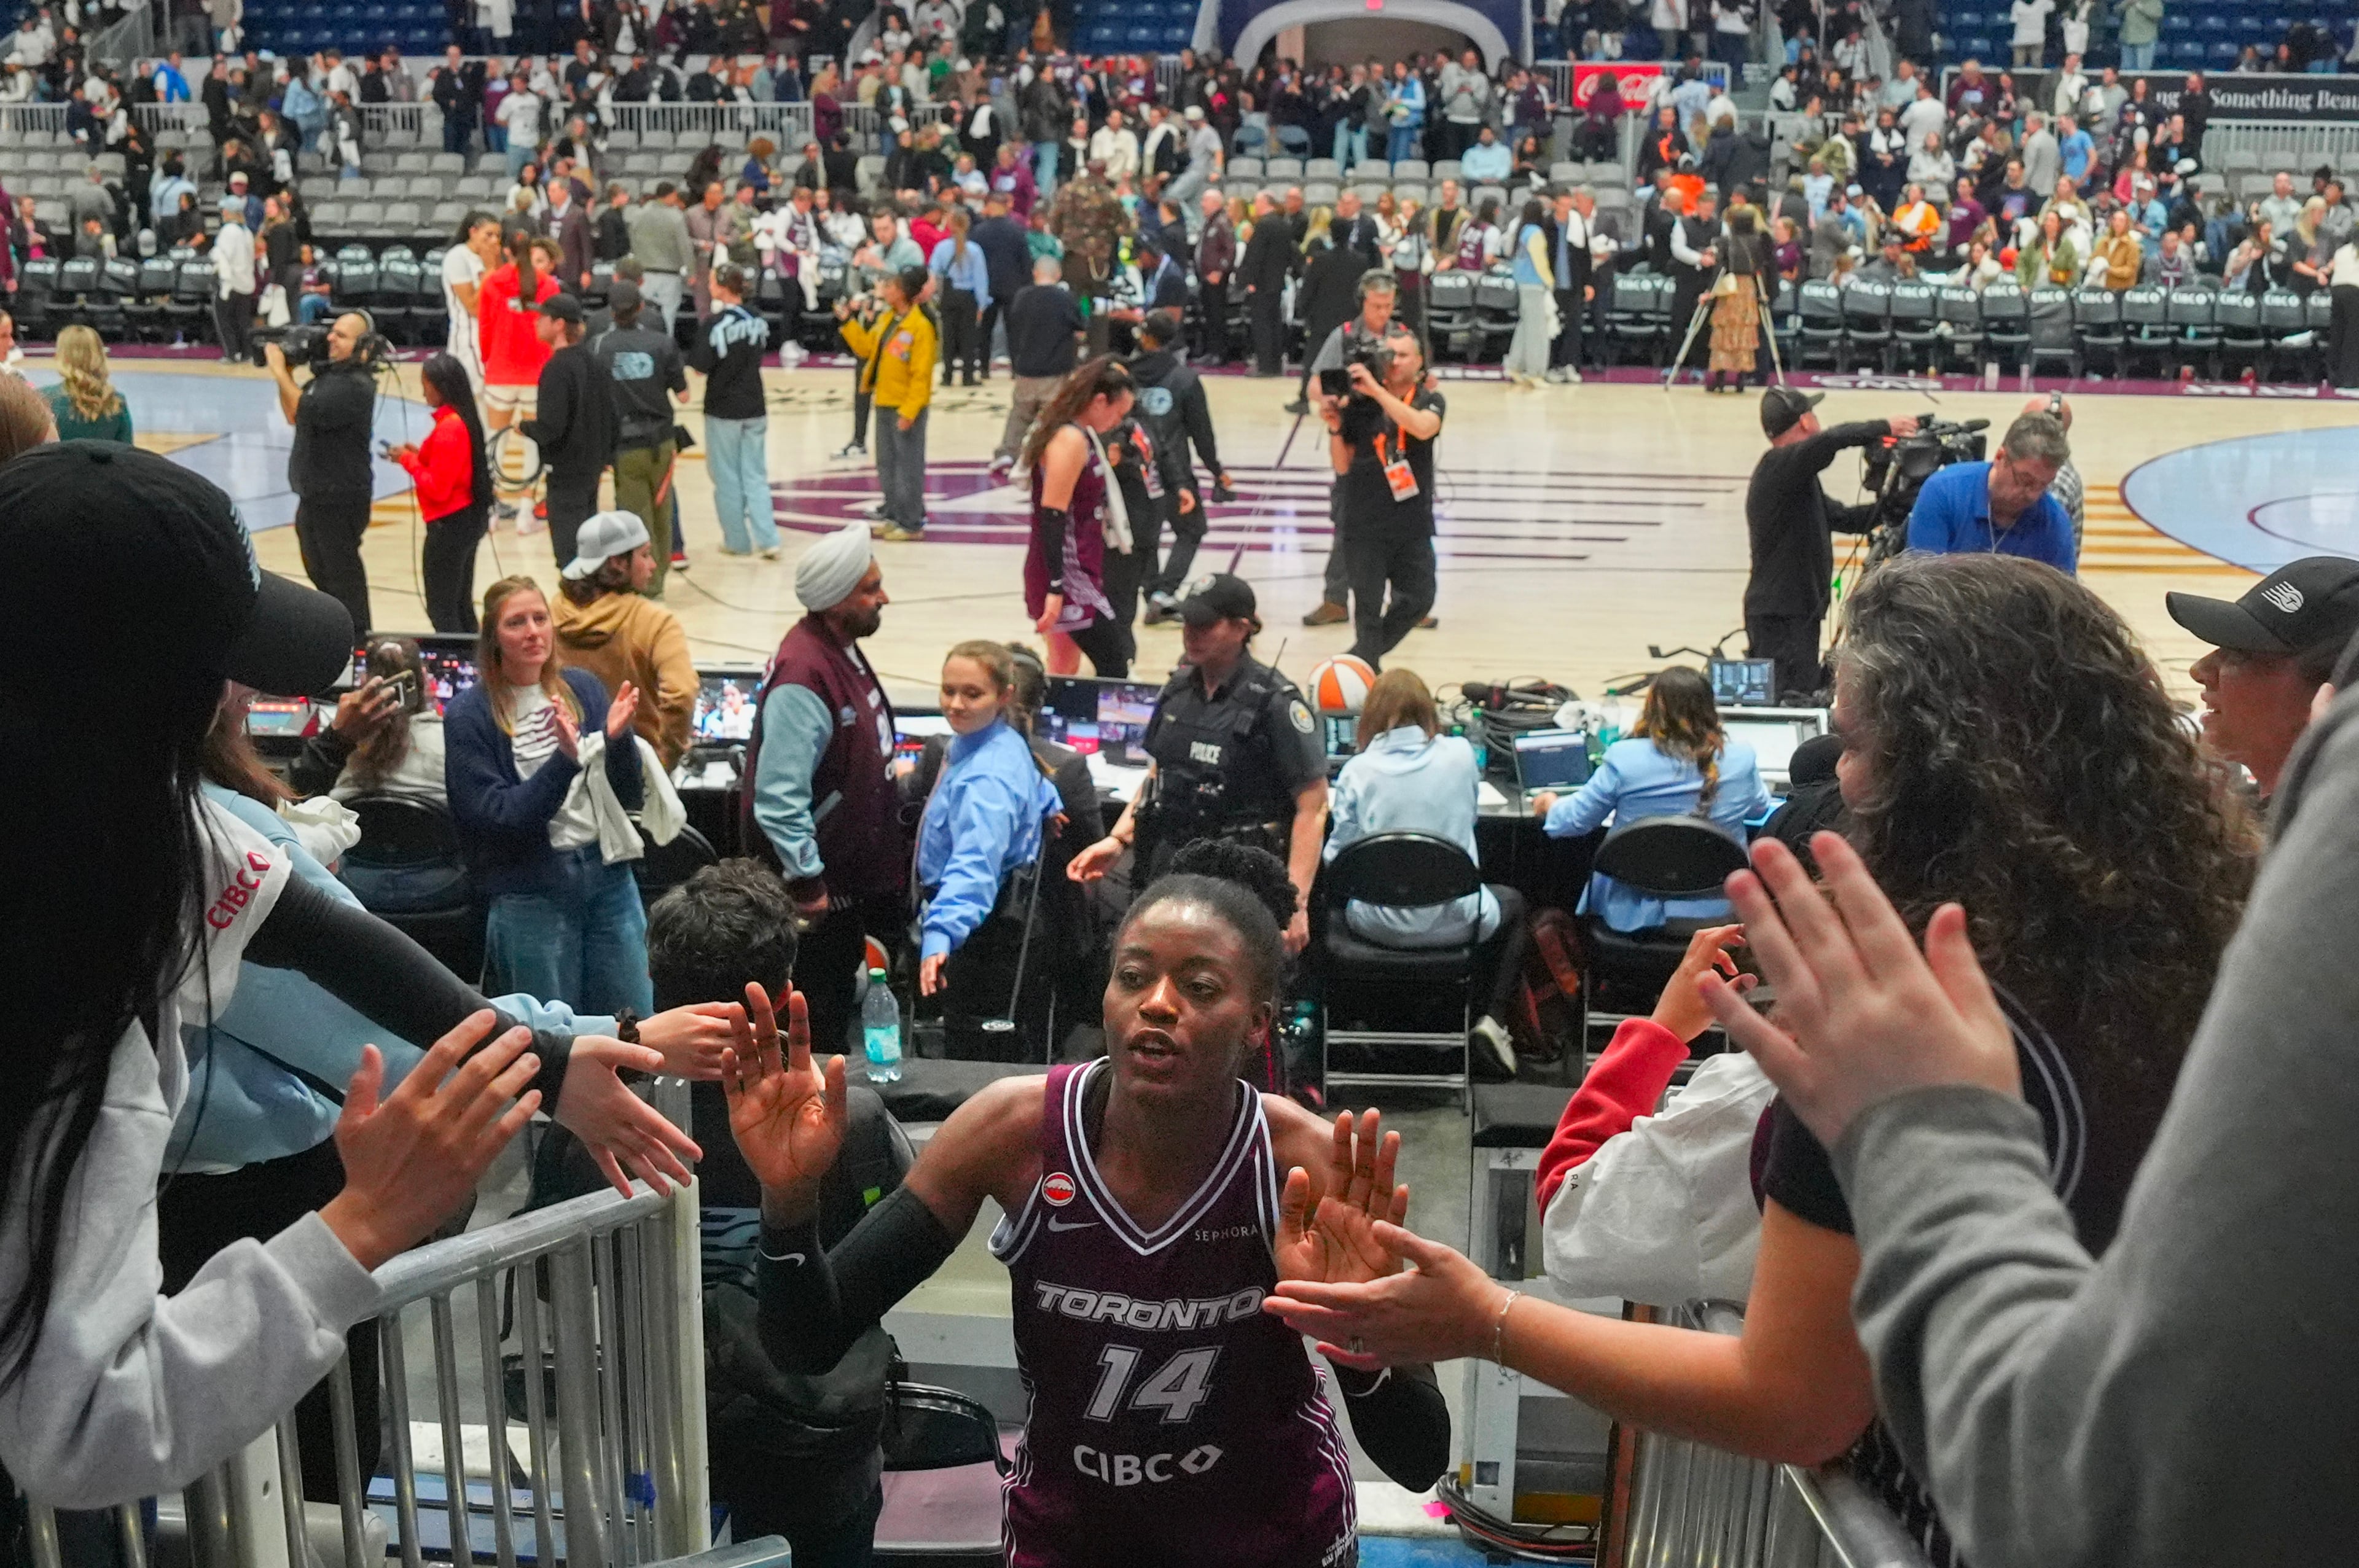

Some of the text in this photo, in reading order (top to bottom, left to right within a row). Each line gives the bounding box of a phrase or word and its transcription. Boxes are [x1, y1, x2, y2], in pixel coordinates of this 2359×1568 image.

[2209, 88, 2313, 112] Something
[1189, 741, 1222, 765] POLICE
[207, 867, 260, 929] CIBC
[1195, 1223, 1259, 1242] SEPHORA
[1034, 1280, 1266, 1330] TORONTO
[1083, 1342, 1223, 1424] 14
[1073, 1444, 1173, 1486] CIBC
